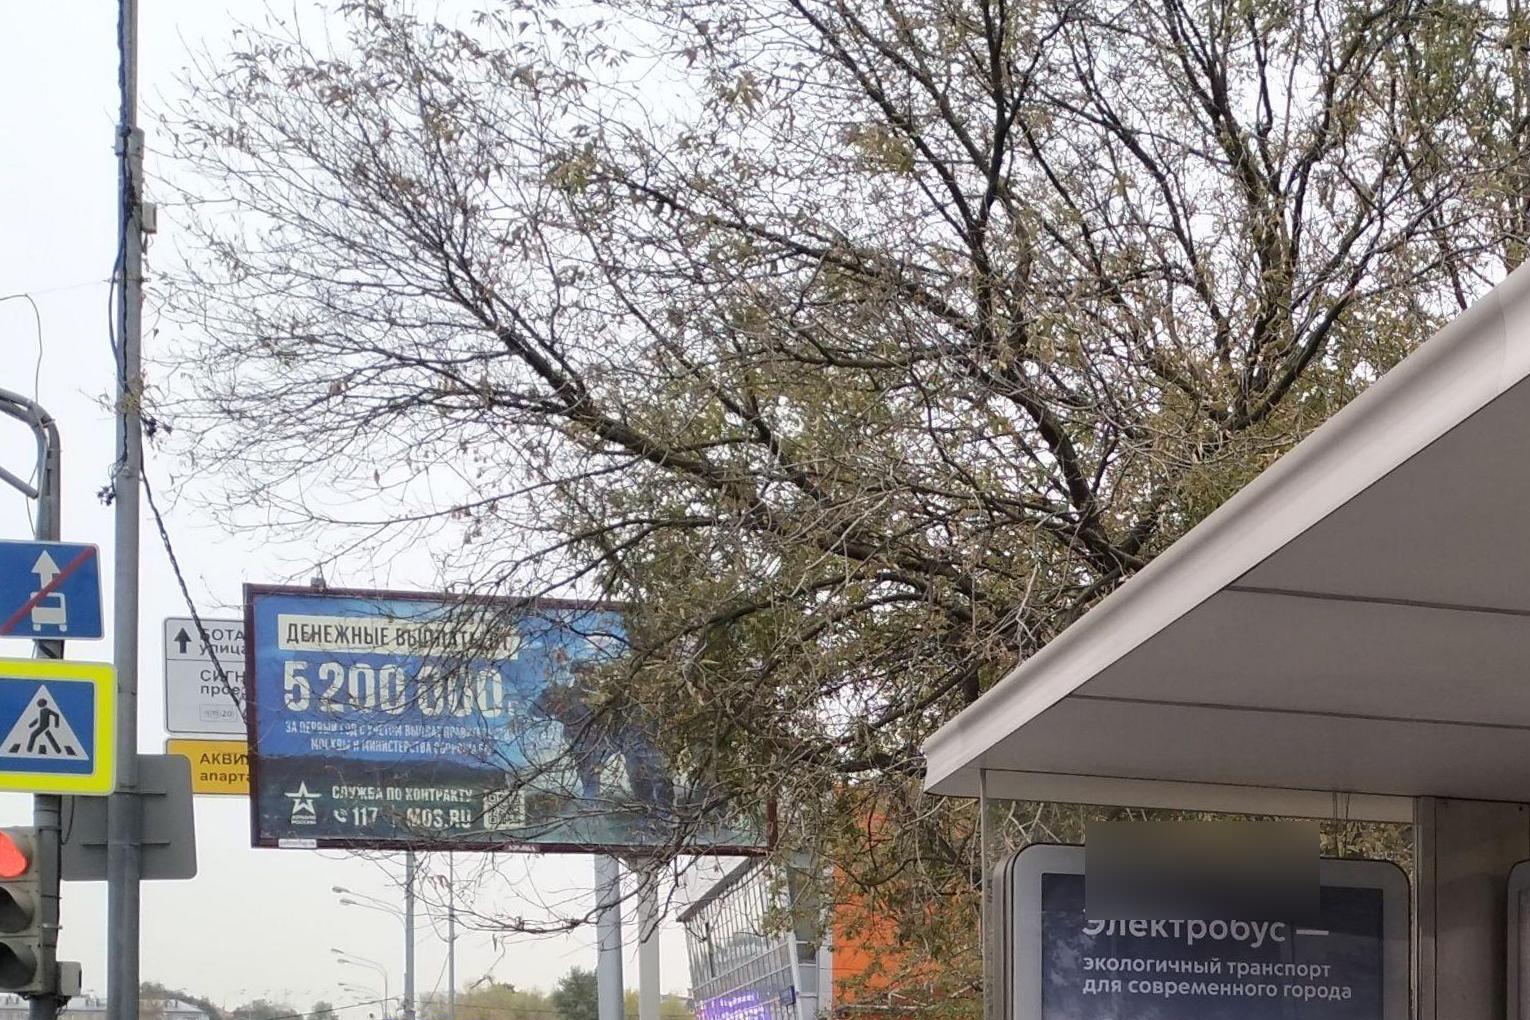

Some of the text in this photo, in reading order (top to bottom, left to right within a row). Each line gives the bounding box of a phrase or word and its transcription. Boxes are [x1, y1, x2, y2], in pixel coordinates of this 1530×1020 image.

[286, 623, 389, 646] ДЕНЕЖНЫЕ
[331, 785, 472, 803] СЛУЖБА ПО КОНТРАКТУ
[352, 807, 472, 828] 117 MOS.RU
[1083, 957, 1331, 980] экологичный транспорт
[1082, 979, 1352, 1001] для современного города
